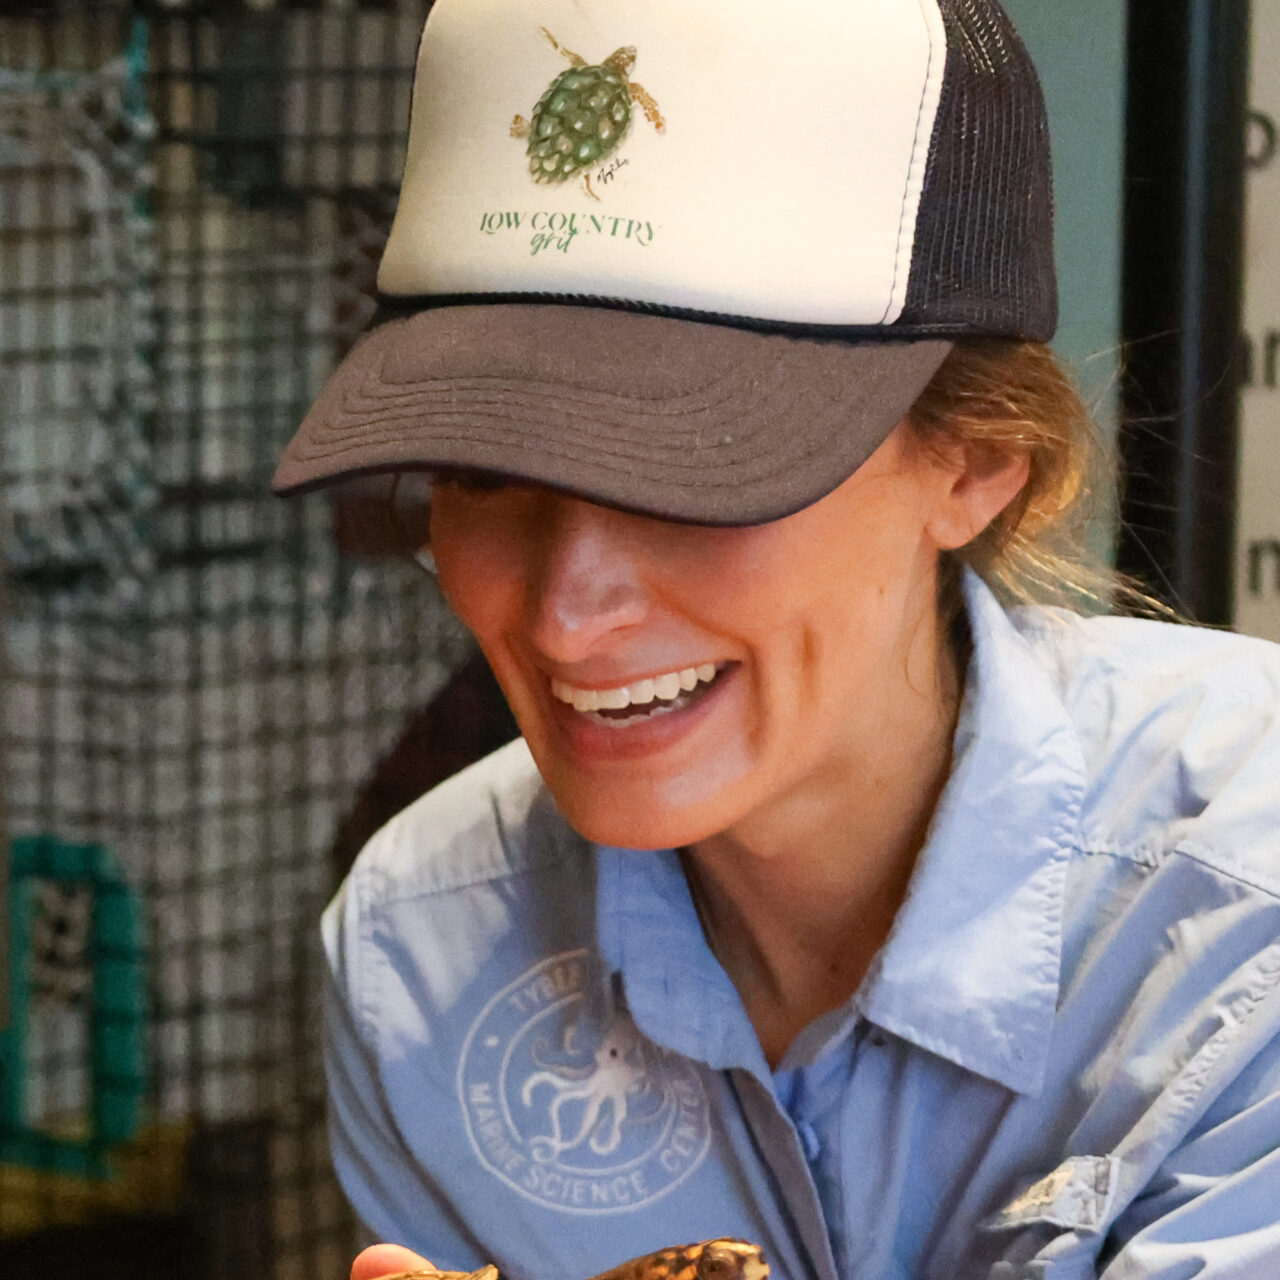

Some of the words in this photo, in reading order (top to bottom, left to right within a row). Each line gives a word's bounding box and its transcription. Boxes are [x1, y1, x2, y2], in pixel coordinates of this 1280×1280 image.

[479, 211, 527, 236] LOW
[530, 211, 661, 247] COUNTRY
[469, 1081, 526, 1172] MARINE
[524, 1163, 649, 1202] SCIENCE
